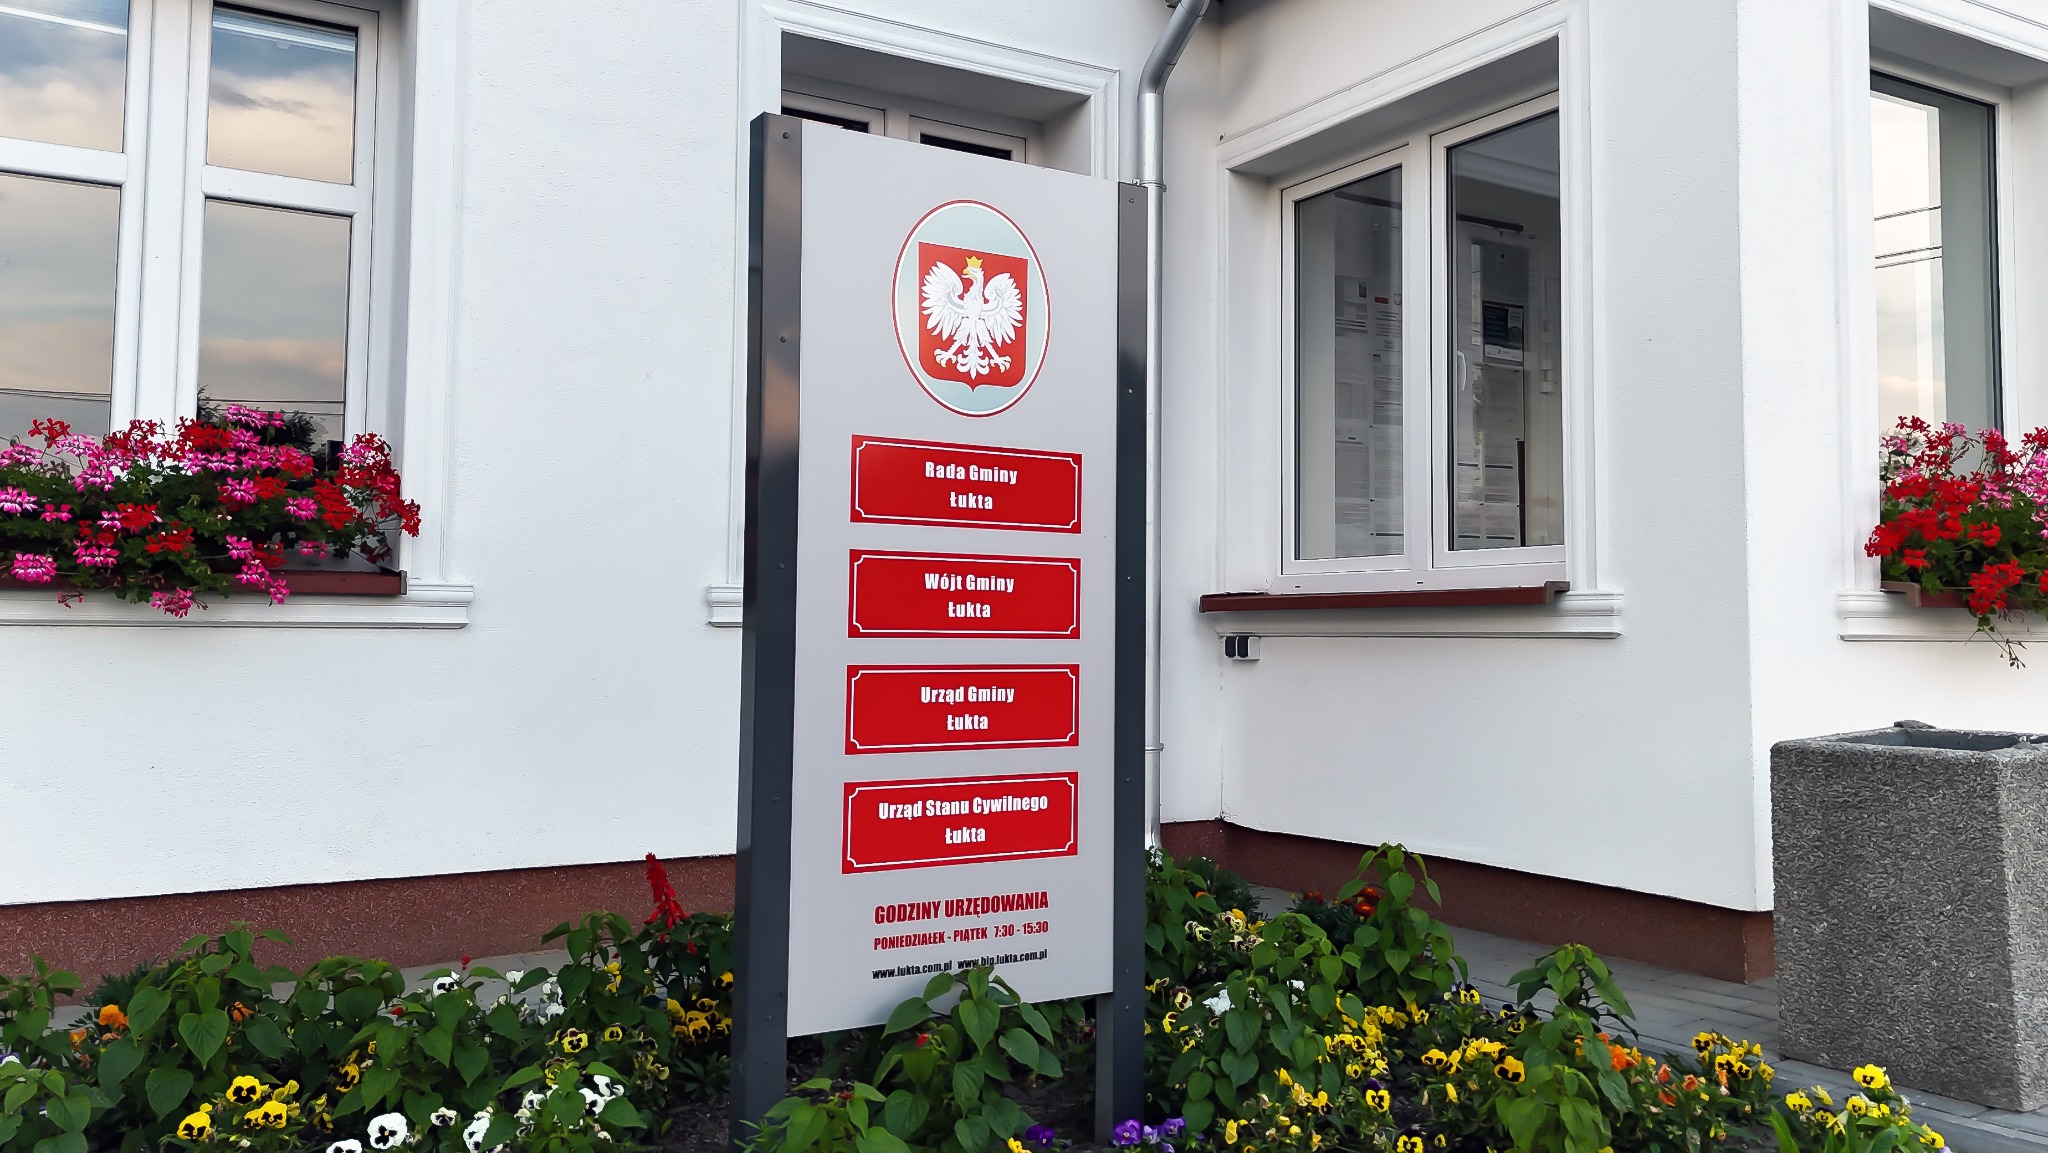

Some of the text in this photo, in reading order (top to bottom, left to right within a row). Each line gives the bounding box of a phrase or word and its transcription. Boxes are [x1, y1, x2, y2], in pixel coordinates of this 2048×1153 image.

[925, 461, 1018, 485] Rada Gminy
[950, 491, 993, 510] Łukta
[924, 572, 1015, 593] Wójt Gminy
[948, 601, 991, 618] Łukta
[920, 686, 1015, 705] Urząd Gminy
[946, 714, 988, 731] Łukta
[878, 795, 1048, 820] Urząd Stanu Cywilnego
[945, 827, 986, 844] Łukta
[874, 891, 1049, 925] GODZINY URZĘDOWANIA
[873, 931, 946, 951] PONIEDZIAŁEK
[953, 926, 988, 944] PIĄTEK
[993, 923, 1015, 938] 7:30
[1022, 920, 1049, 935] 15:30
[872, 949, 1048, 979] www.lukta.com.pl wwwbip.lukta.com.pl
